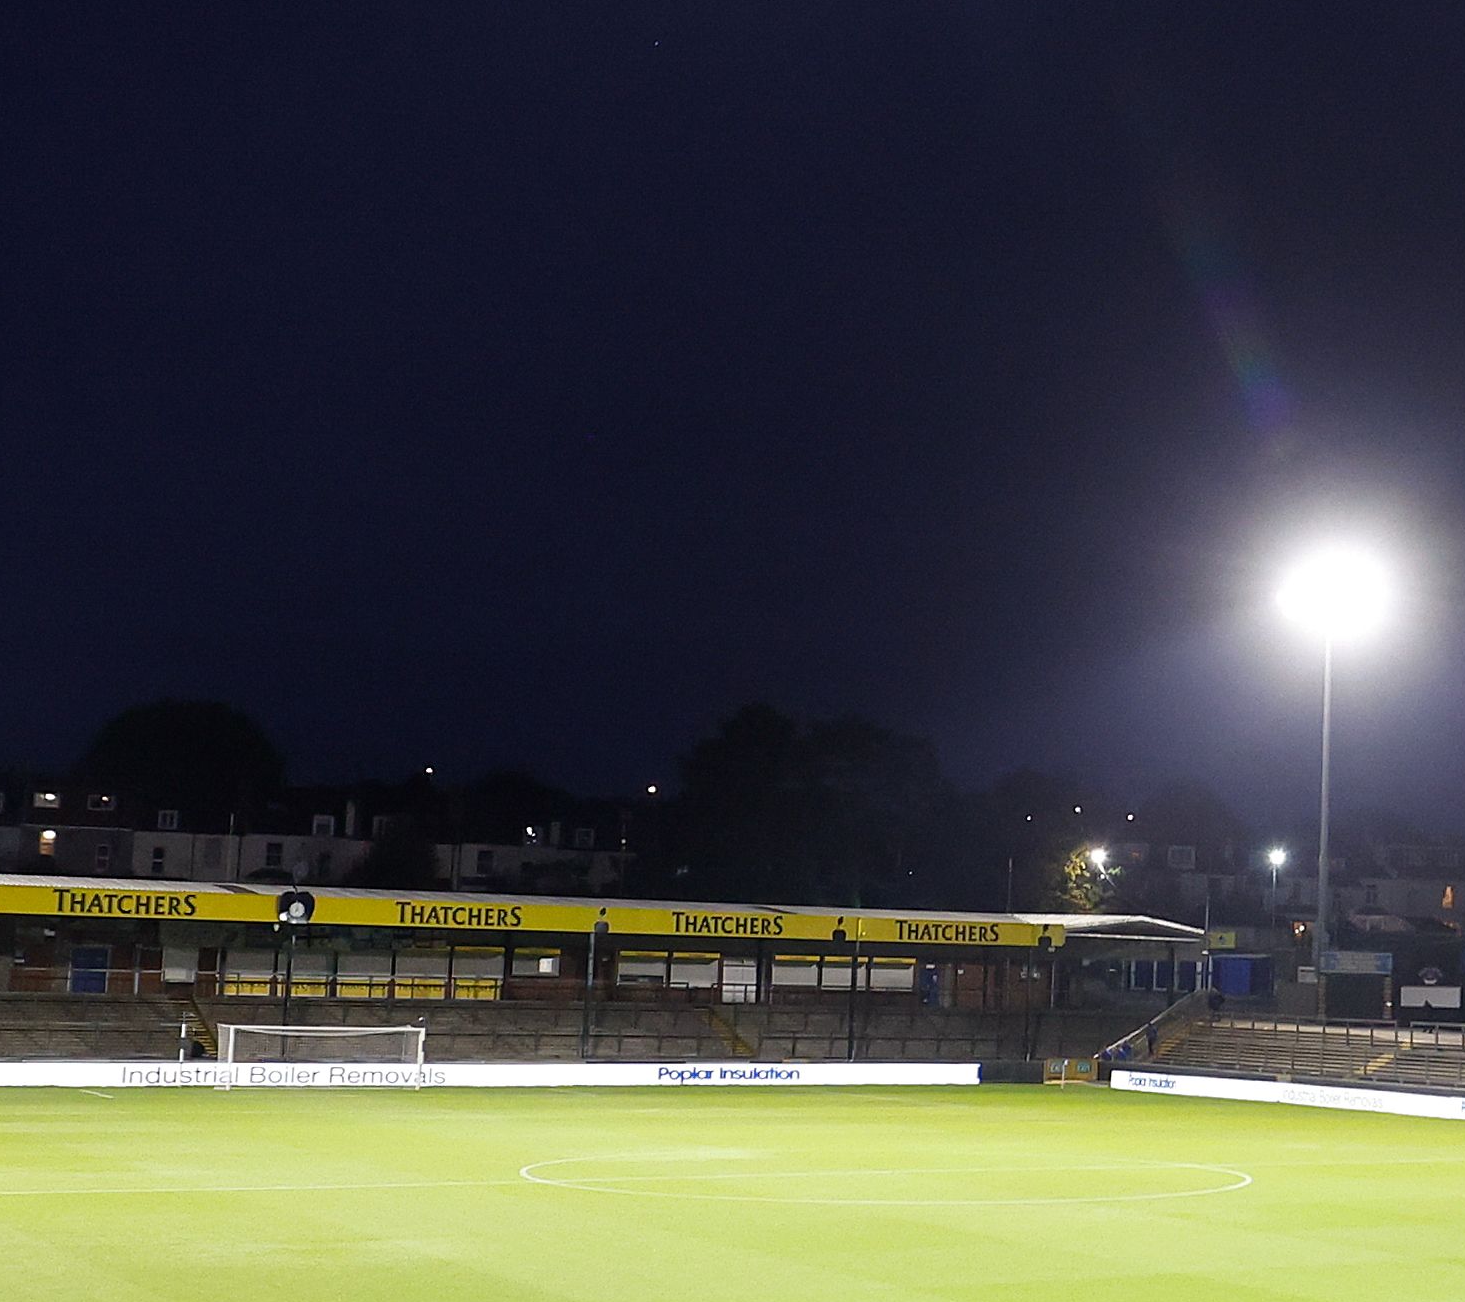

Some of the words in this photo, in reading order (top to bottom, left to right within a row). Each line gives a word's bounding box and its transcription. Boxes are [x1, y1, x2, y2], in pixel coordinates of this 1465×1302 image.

[121, 1066, 238, 1085] Industrial
[250, 1066, 319, 1084] Boiler
[330, 1066, 446, 1085] Removals
[658, 1067, 713, 1083] Poplar
[720, 1067, 800, 1080] Insulation
